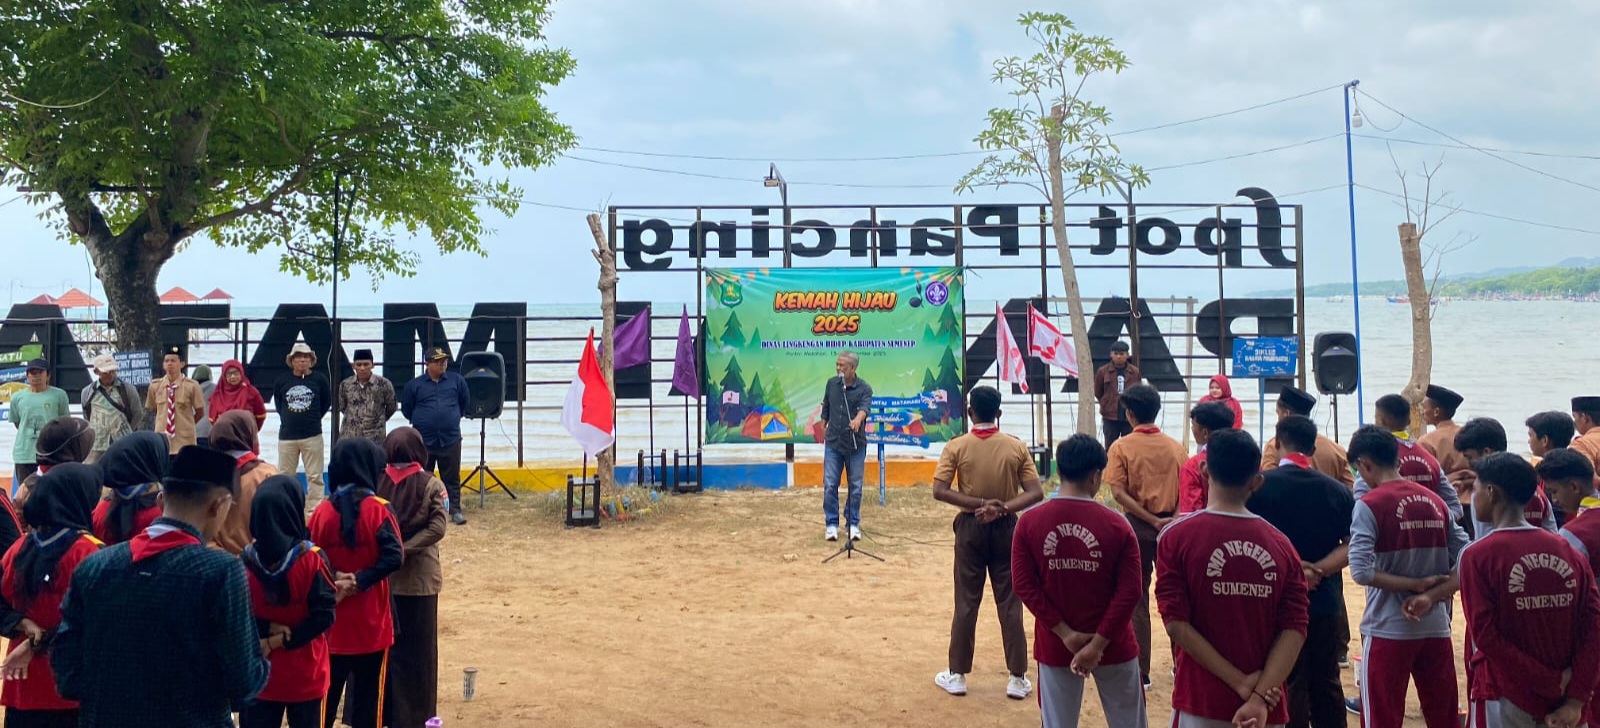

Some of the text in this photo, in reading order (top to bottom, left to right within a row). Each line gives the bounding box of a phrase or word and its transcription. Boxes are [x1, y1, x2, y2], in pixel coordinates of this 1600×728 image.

[773, 290, 897, 312] KEMAH HIJAU
[812, 314, 861, 336] 2025
[1043, 523, 1102, 558] SMP NEGERI 5
[1048, 558, 1100, 572] SUMENEP
[1206, 540, 1277, 581] SMP NEGERI 5
[1508, 553, 1577, 593] SMP NEGERI 5
[1212, 581, 1272, 598] SUMENEP
[1515, 593, 1574, 610] SUMENEP
